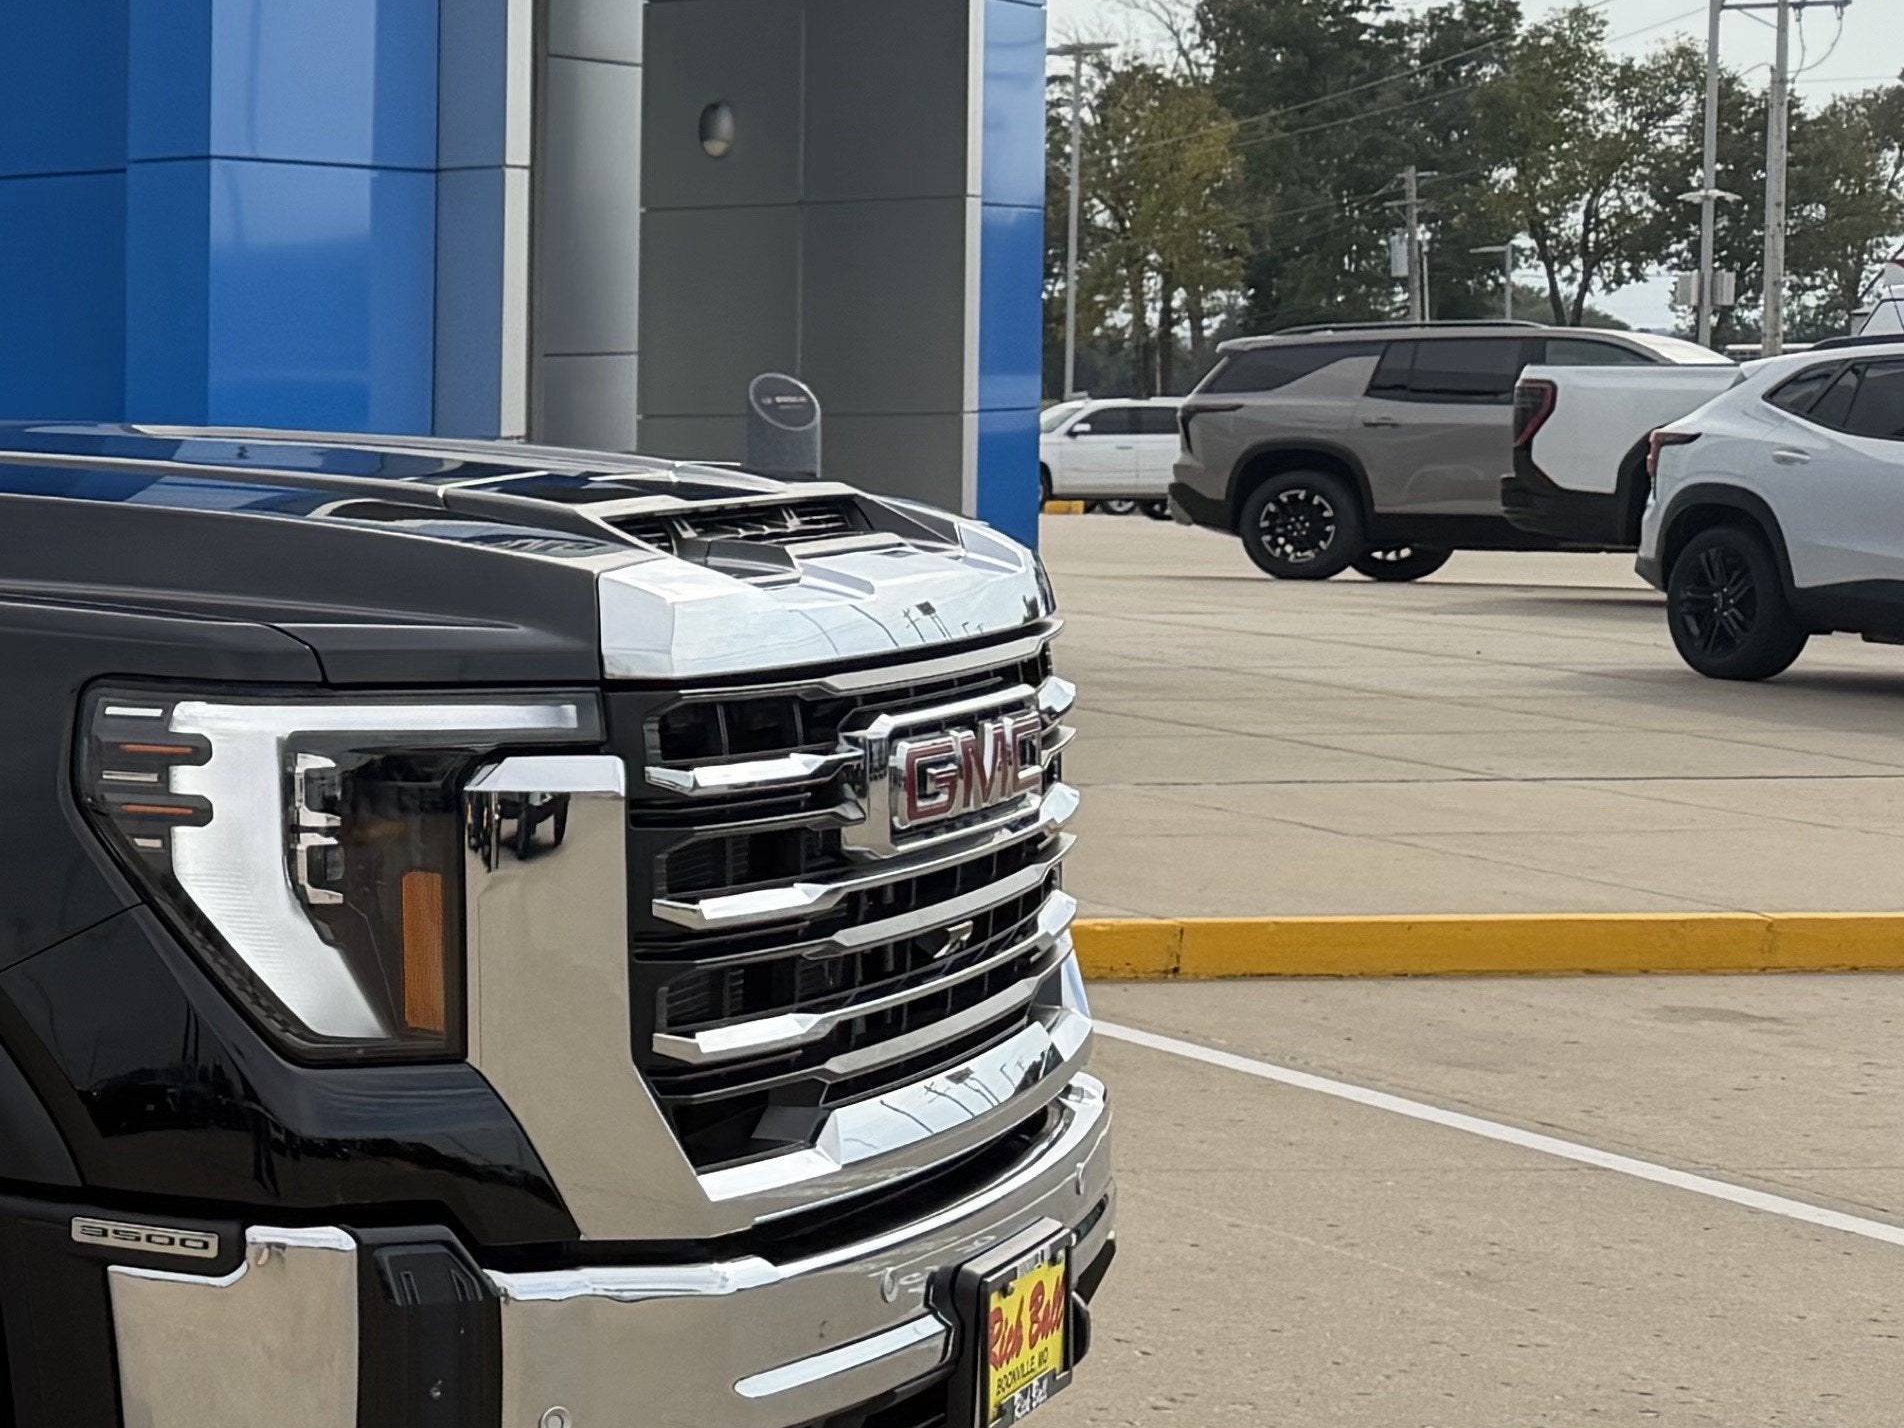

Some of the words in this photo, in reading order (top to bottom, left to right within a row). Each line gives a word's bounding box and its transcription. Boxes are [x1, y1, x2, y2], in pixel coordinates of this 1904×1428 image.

[894, 710, 1042, 829] GMC
[79, 1224, 210, 1251] 3500
[988, 1294, 1025, 1372] Rick
[1028, 1271, 1066, 1350] Ball
